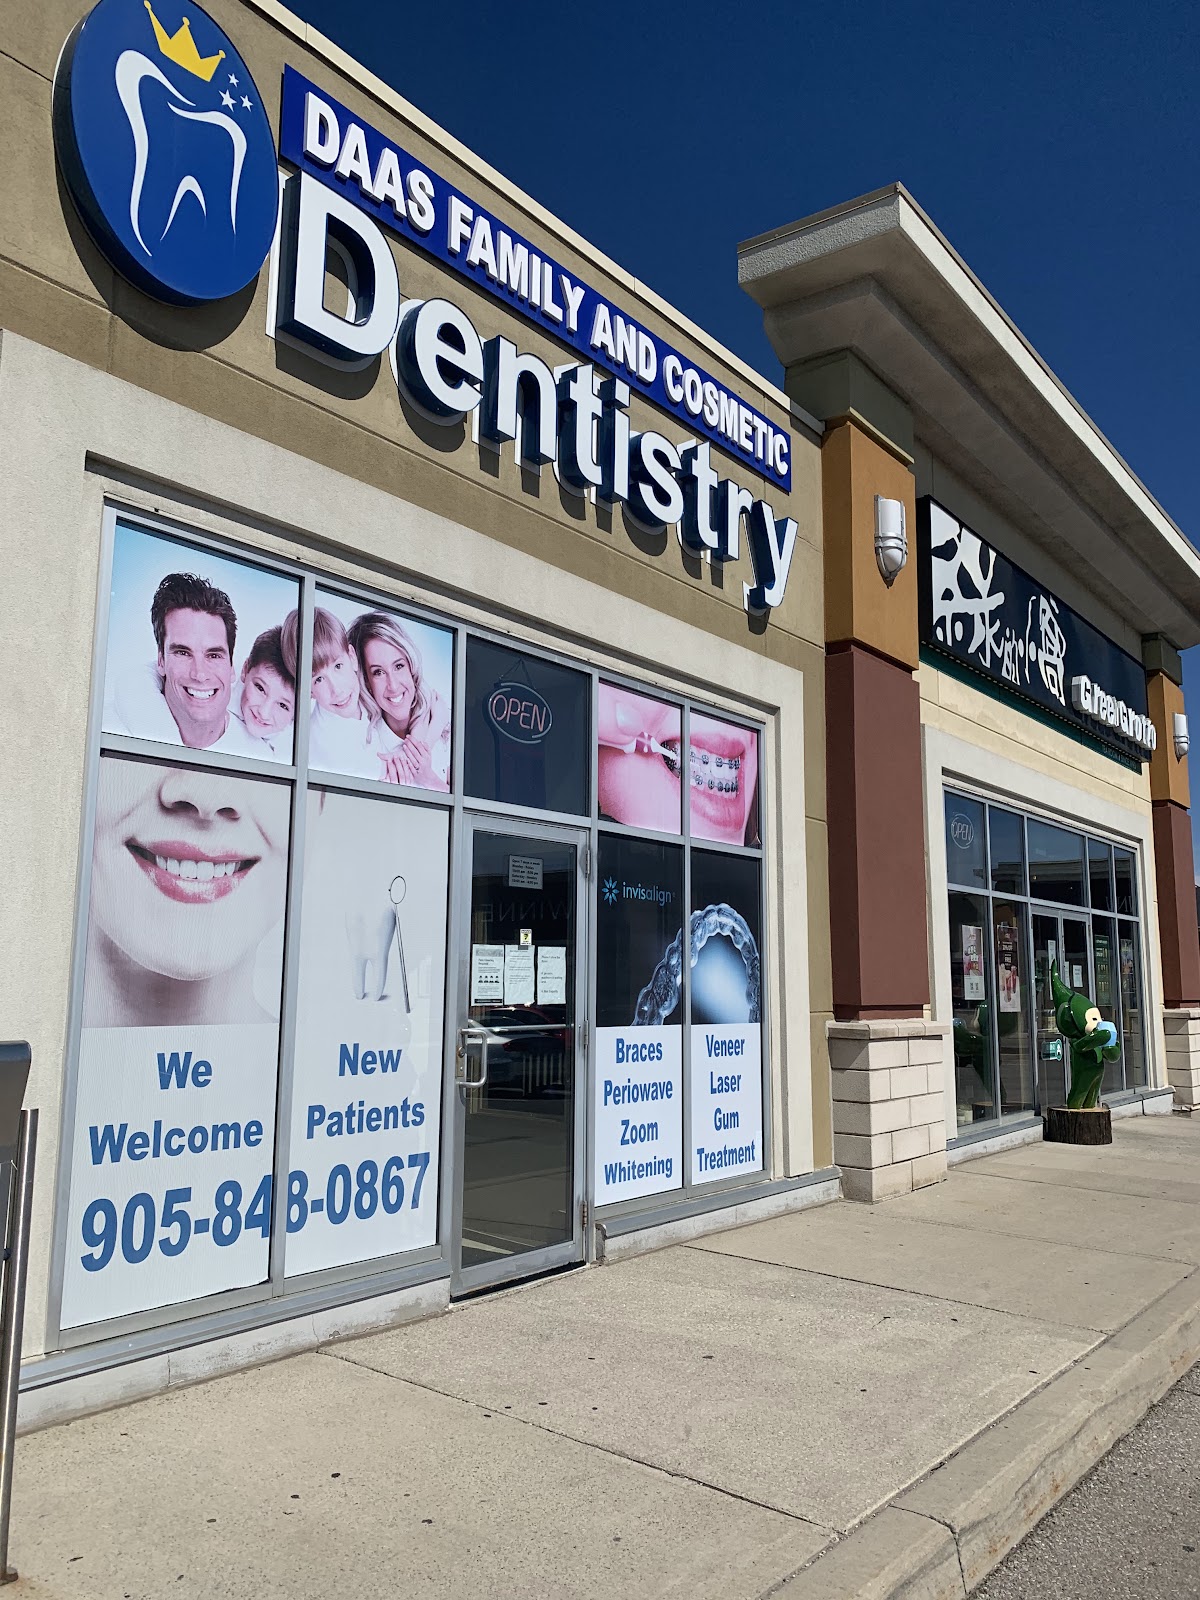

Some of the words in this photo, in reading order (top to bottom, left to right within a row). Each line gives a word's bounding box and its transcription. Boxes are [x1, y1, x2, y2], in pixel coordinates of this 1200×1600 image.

[303, 91, 435, 232] DAAS
[447, 195, 585, 333] FAMILY
[590, 303, 657, 383] AND
[662, 354, 788, 476] COSMETIC
[284, 169, 798, 608] Dentistry
[492, 694, 546, 732] OPEN
[951, 821, 973, 841] OPEN
[622, 881, 672, 906] invisalign
[338, 1043, 403, 1077] New
[615, 1038, 663, 1064] Braces
[705, 1035, 746, 1058] Veneer
[157, 1051, 213, 1090] We
[710, 1071, 742, 1095] Laser
[603, 1078, 673, 1107] Periowave
[306, 1097, 425, 1140] Patients
[620, 1119, 659, 1146] Zoom
[714, 1108, 740, 1132] Gum
[89, 1119, 264, 1165] Welcome
[697, 1140, 756, 1172] Treatment
[604, 1157, 673, 1186] Whitening
